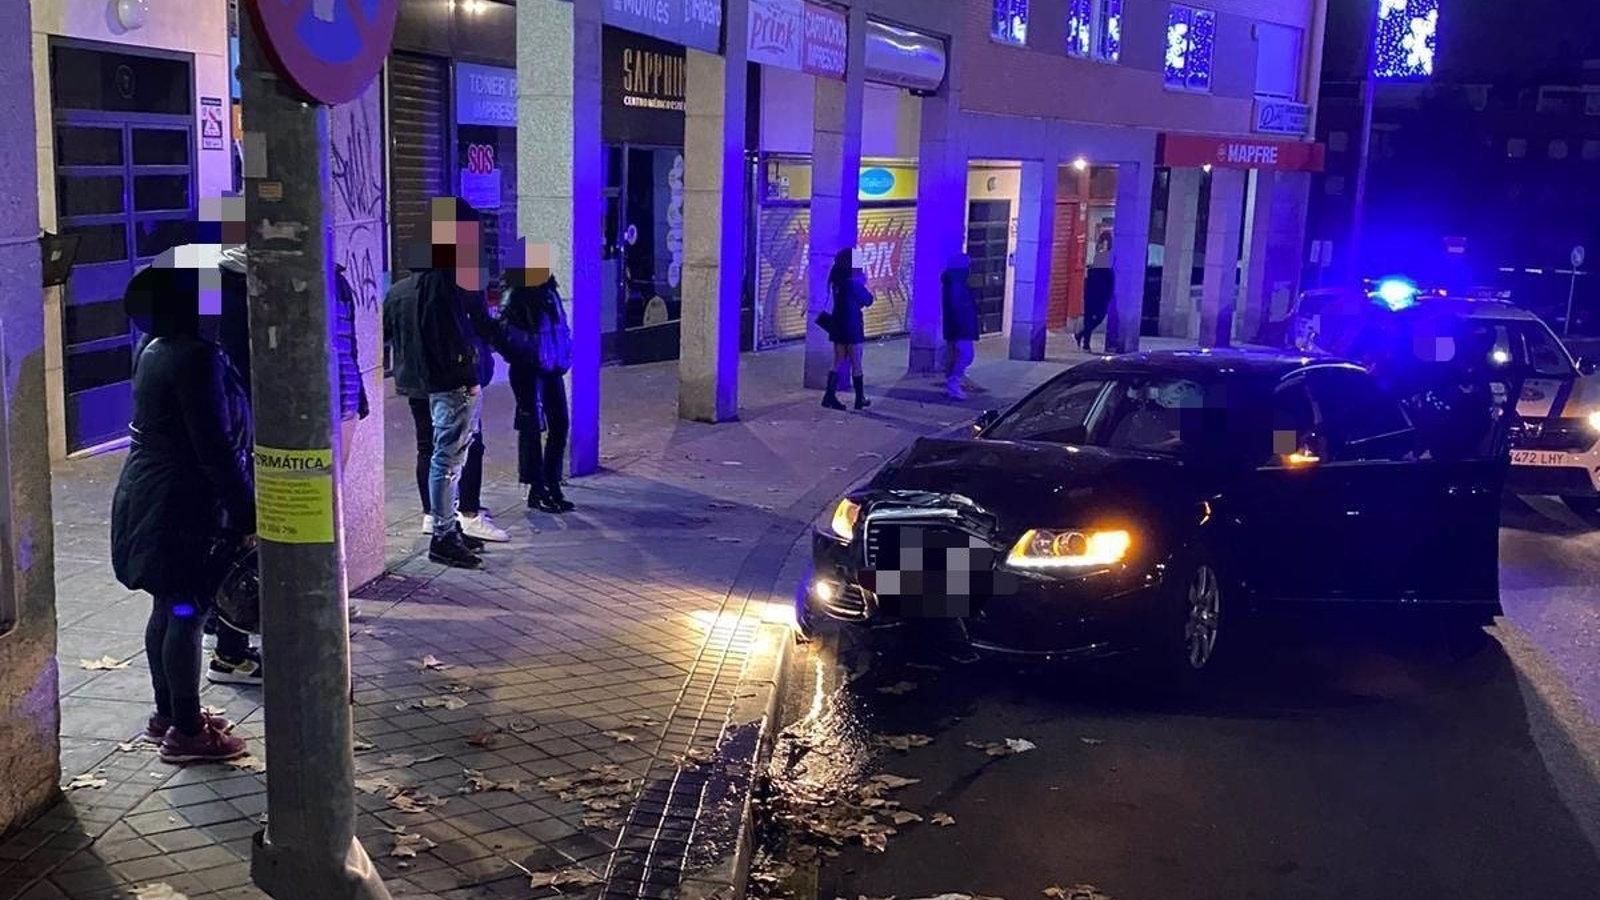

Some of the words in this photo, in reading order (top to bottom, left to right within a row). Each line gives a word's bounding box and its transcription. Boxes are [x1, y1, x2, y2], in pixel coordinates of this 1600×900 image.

[751, 12, 797, 51] prink
[468, 144, 494, 174] SOS
[1228, 143, 1278, 164] MAPFRE
[1509, 451, 1537, 463] 472
[1540, 452, 1564, 464] LHY
